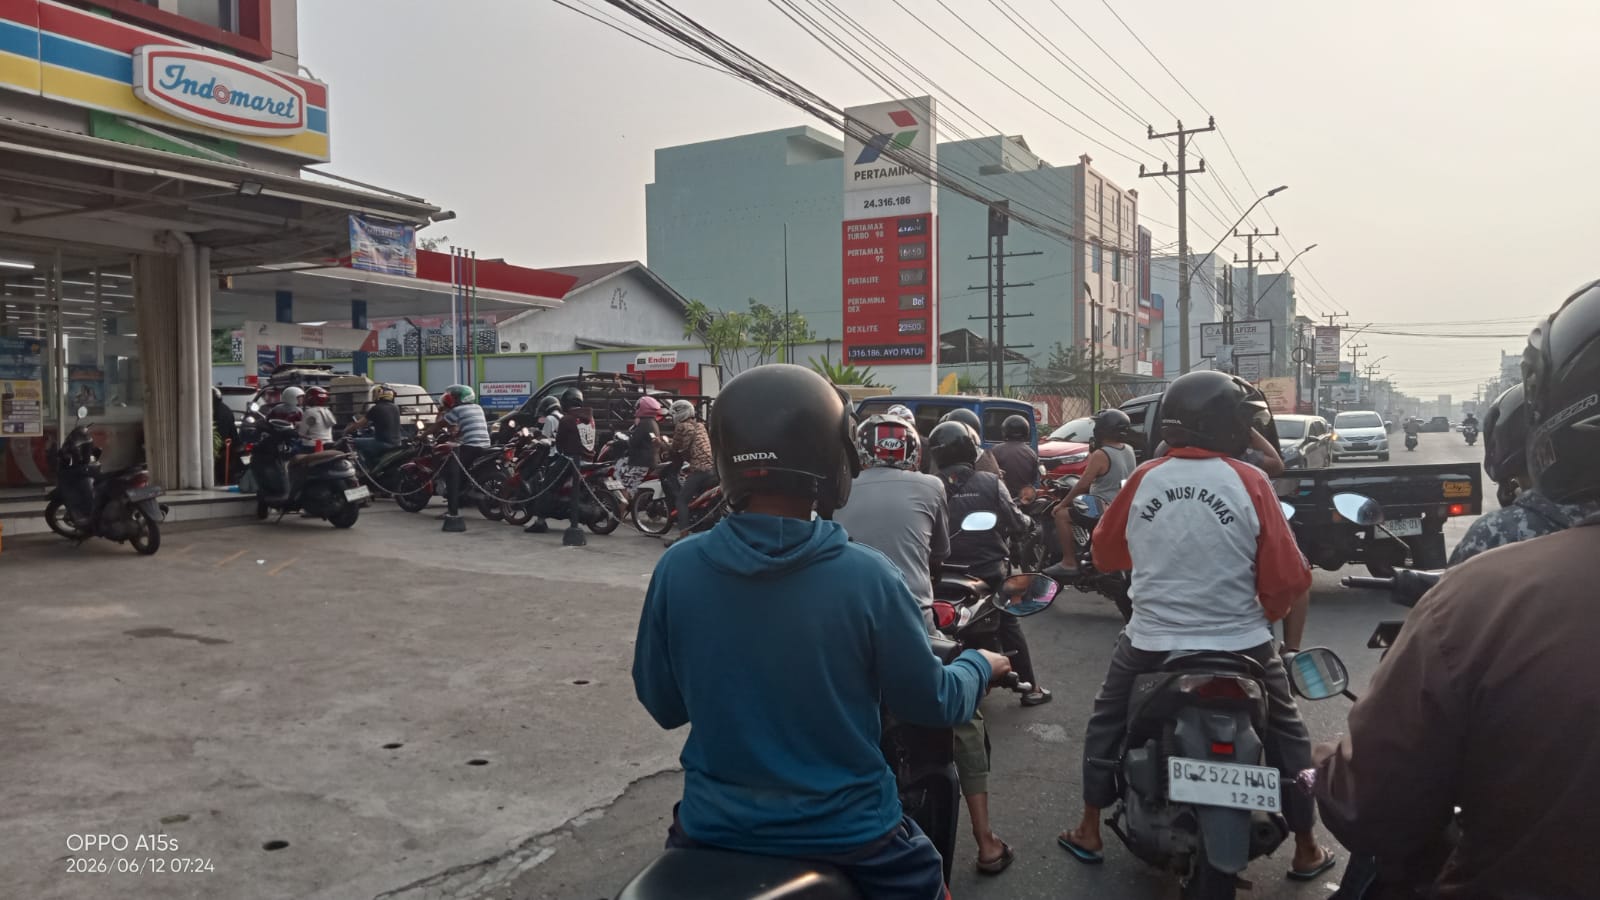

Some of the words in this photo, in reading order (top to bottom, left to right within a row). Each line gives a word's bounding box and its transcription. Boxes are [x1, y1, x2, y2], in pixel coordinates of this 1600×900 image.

[159, 65, 295, 119] Indomaret
[854, 166, 915, 180] PERTAMIN
[847, 223, 884, 232] PERTAMAX
[847, 232, 869, 240] TURBO
[847, 247, 884, 256] PERTAMAX
[847, 276, 880, 285] PERTALITE
[847, 297, 886, 305] PERTAMINA
[847, 305, 860, 313] DEX
[847, 325, 879, 333] DEXLITE
[883, 347, 899, 356] AYO
[733, 451, 778, 463] HONDA
[1140, 498, 1163, 522] KAB
[1165, 486, 1196, 503] MUSI
[1197, 488, 1235, 525] RAWAS
[1199, 765, 1241, 786] 2522
[1244, 770, 1276, 790] HAG
